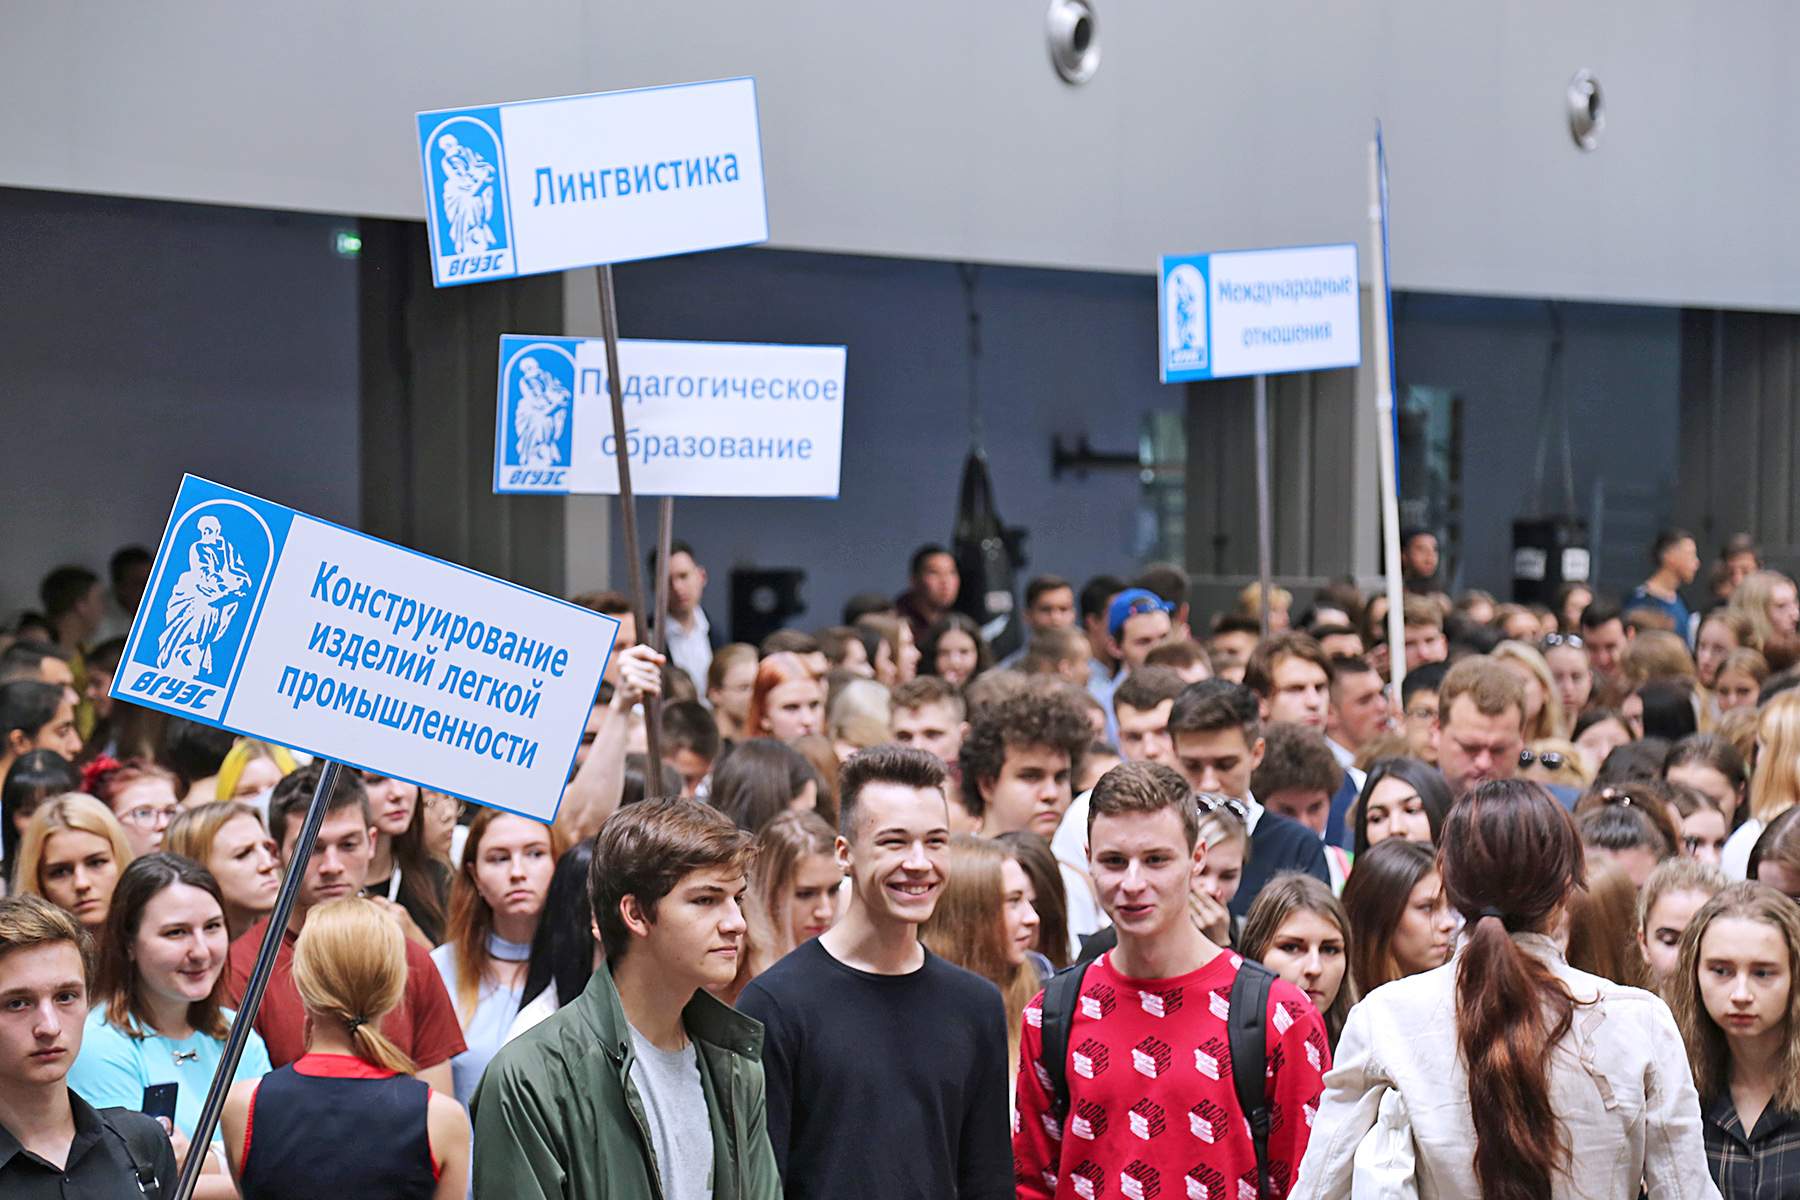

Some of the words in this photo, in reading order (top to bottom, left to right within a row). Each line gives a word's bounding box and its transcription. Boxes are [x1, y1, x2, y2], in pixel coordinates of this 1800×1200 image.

[533, 153, 740, 208] Лингвистика
[447, 252, 505, 277] ВГУЭС
[1217, 276, 1353, 304] Международные
[1242, 322, 1333, 347] отношения
[601, 428, 813, 464] образование
[310, 561, 569, 678] Конструирование
[308, 621, 436, 687] изделий
[438, 664, 544, 720] легкой
[130, 671, 217, 710] ВГУЭС
[277, 665, 540, 770] промышленности
